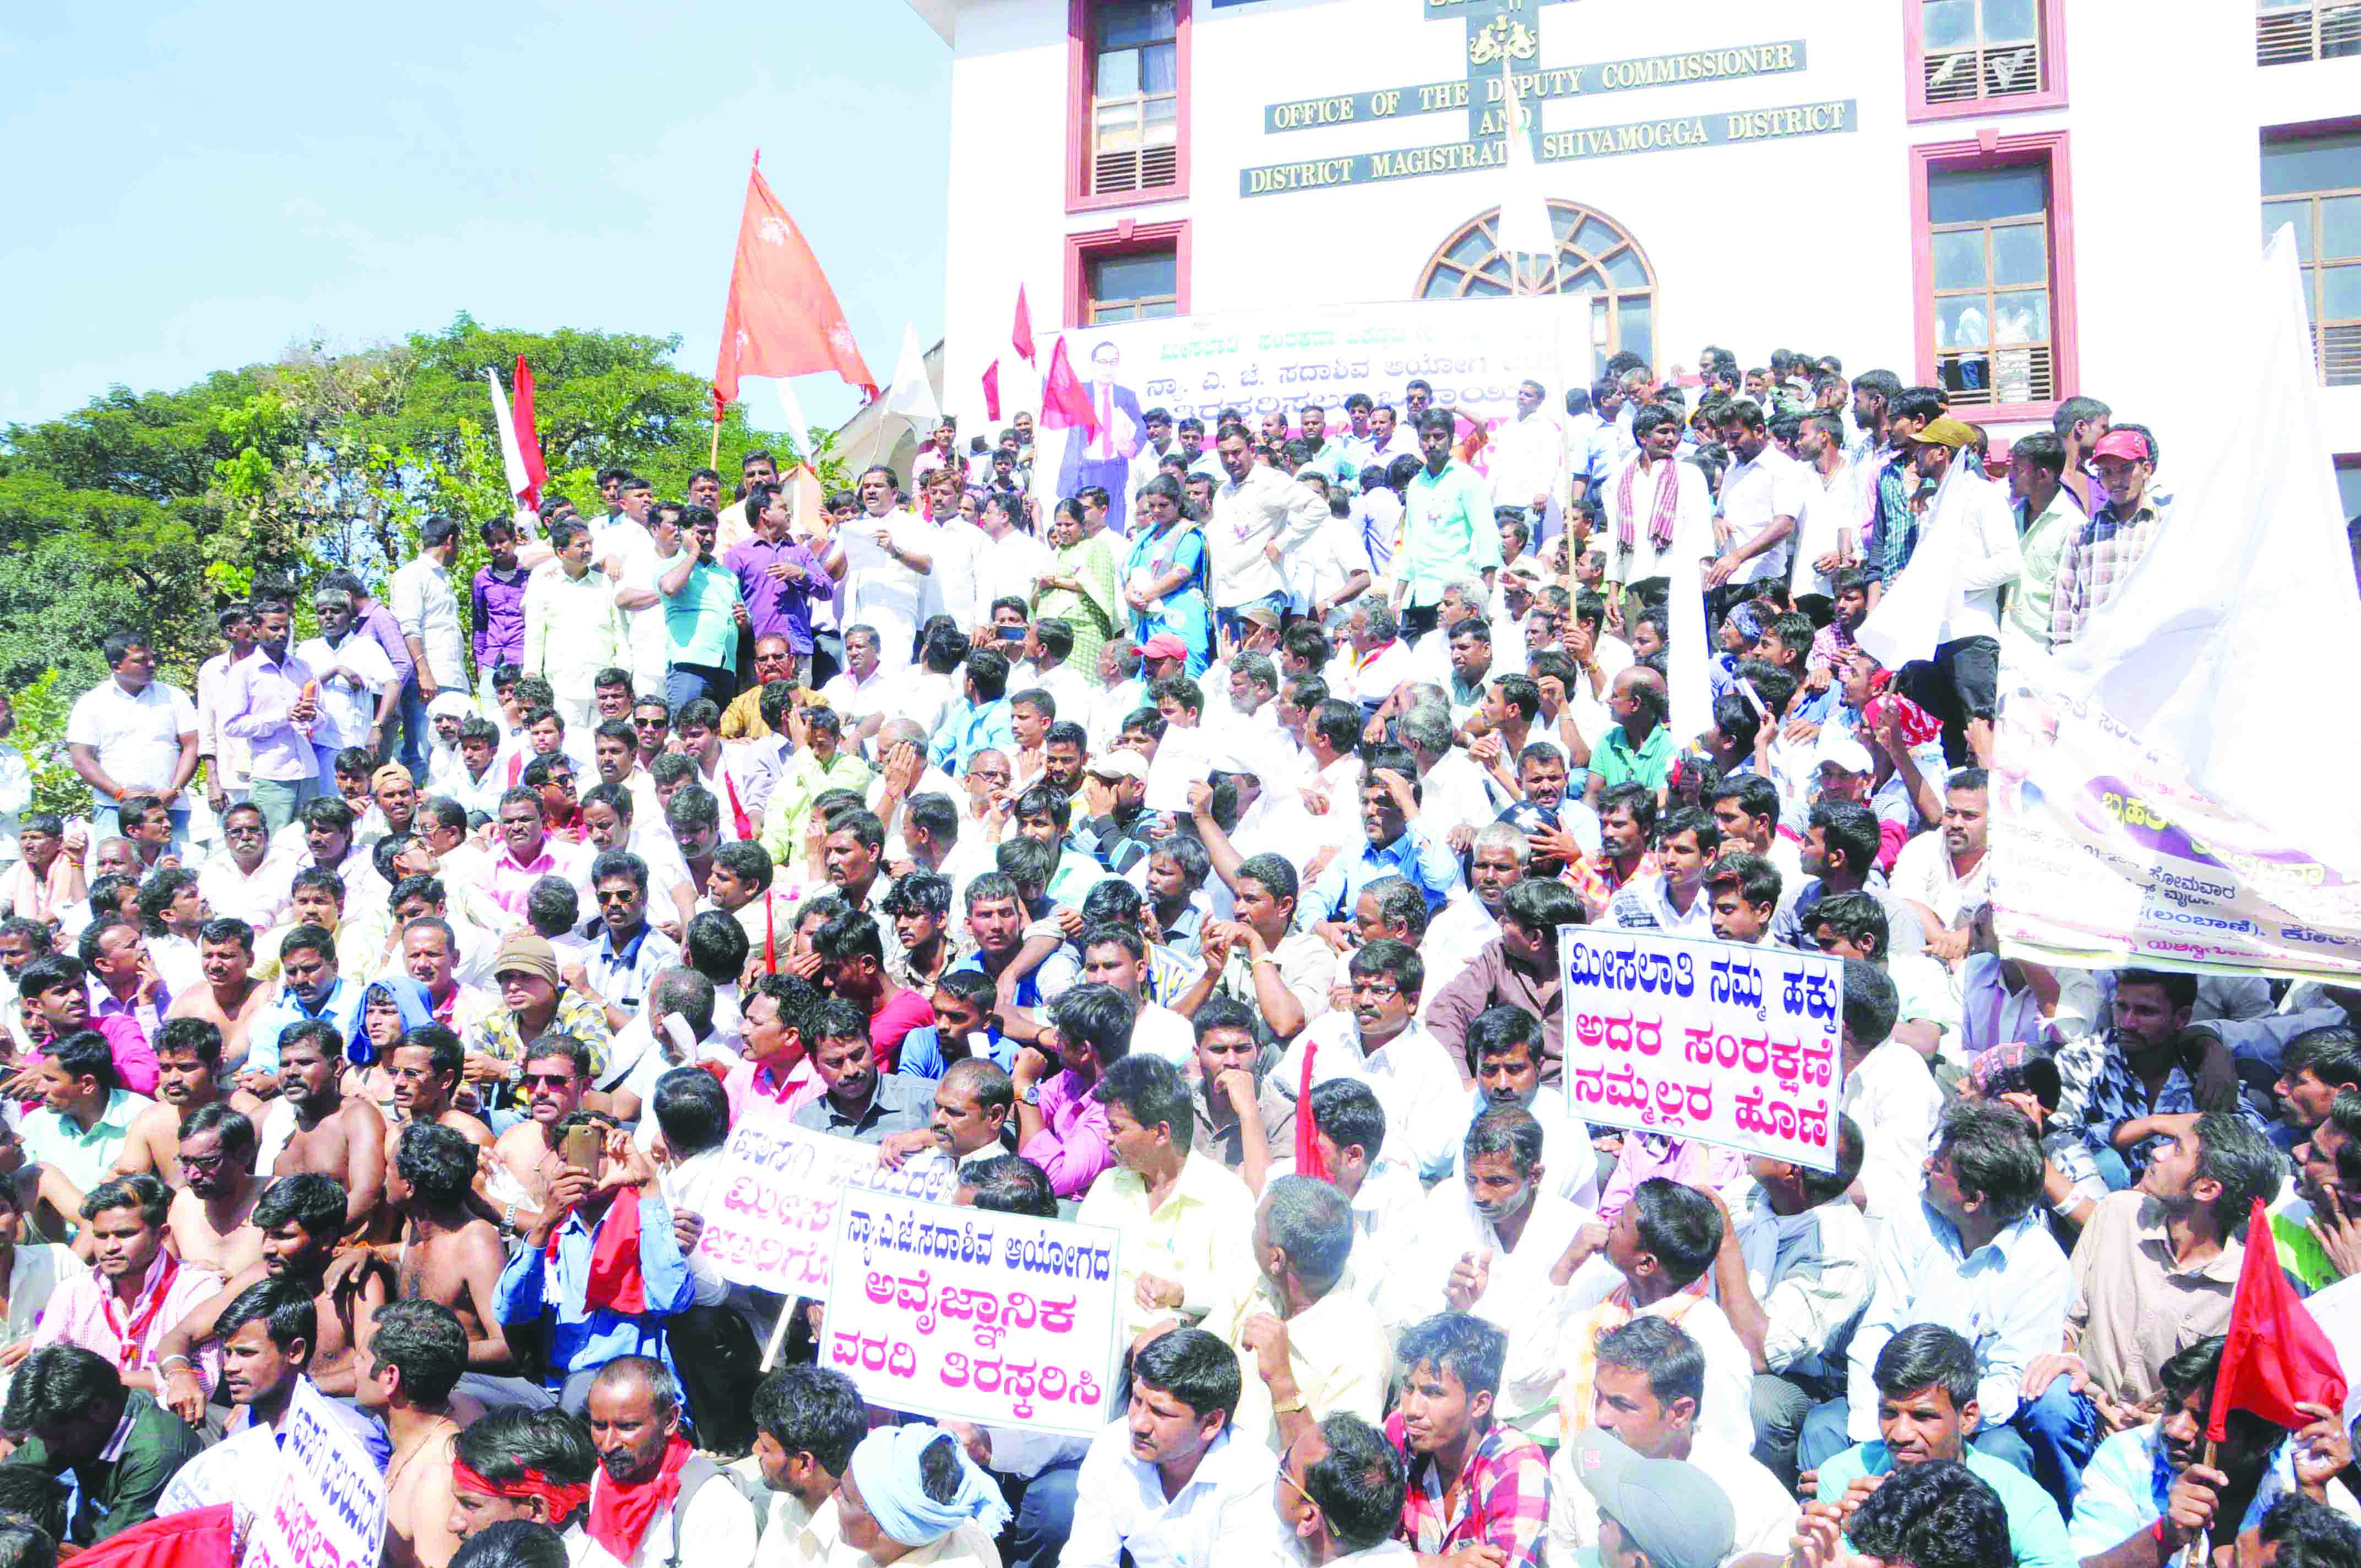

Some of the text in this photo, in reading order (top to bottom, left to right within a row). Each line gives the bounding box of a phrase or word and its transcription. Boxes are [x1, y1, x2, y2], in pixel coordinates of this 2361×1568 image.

[1274, 43, 1796, 129] OFFICE OF THE DPUTY COMMISSIONER
[1249, 101, 1846, 194] DISTRICT MAGISTRAT SHIVAMOGGA DISTRICT
[1279, 357, 1370, 384] ಸದಾಶಿವ
[2148, 865, 2235, 900] ಸೋಮವಾರ
[1571, 939, 1837, 1035] ಮೀಸಲಾತಿ ನಮ್ಮ ಹಕ್ಕು
[1576, 1009, 1834, 1097] ಅದರ ಸಂರಕ್ಷಣೆ
[1575, 1061, 1829, 1147] ನಮ್ಮೆಲ್ಲರ ಹೊಣೆ
[724, 1175, 838, 1232] ಮೀಸ
[848, 1210, 1111, 1281] ನ್ಯಾ.ಎ.ಜೆ.ಸದಾಶಿವ ಆಯೋಗದ
[863, 1269, 1077, 1349] ಅವೈಜ್ಞಾನಿಕ
[832, 1330, 1102, 1419] ವರದಿ ತಿರಸ್ಕರಿಸಿ
